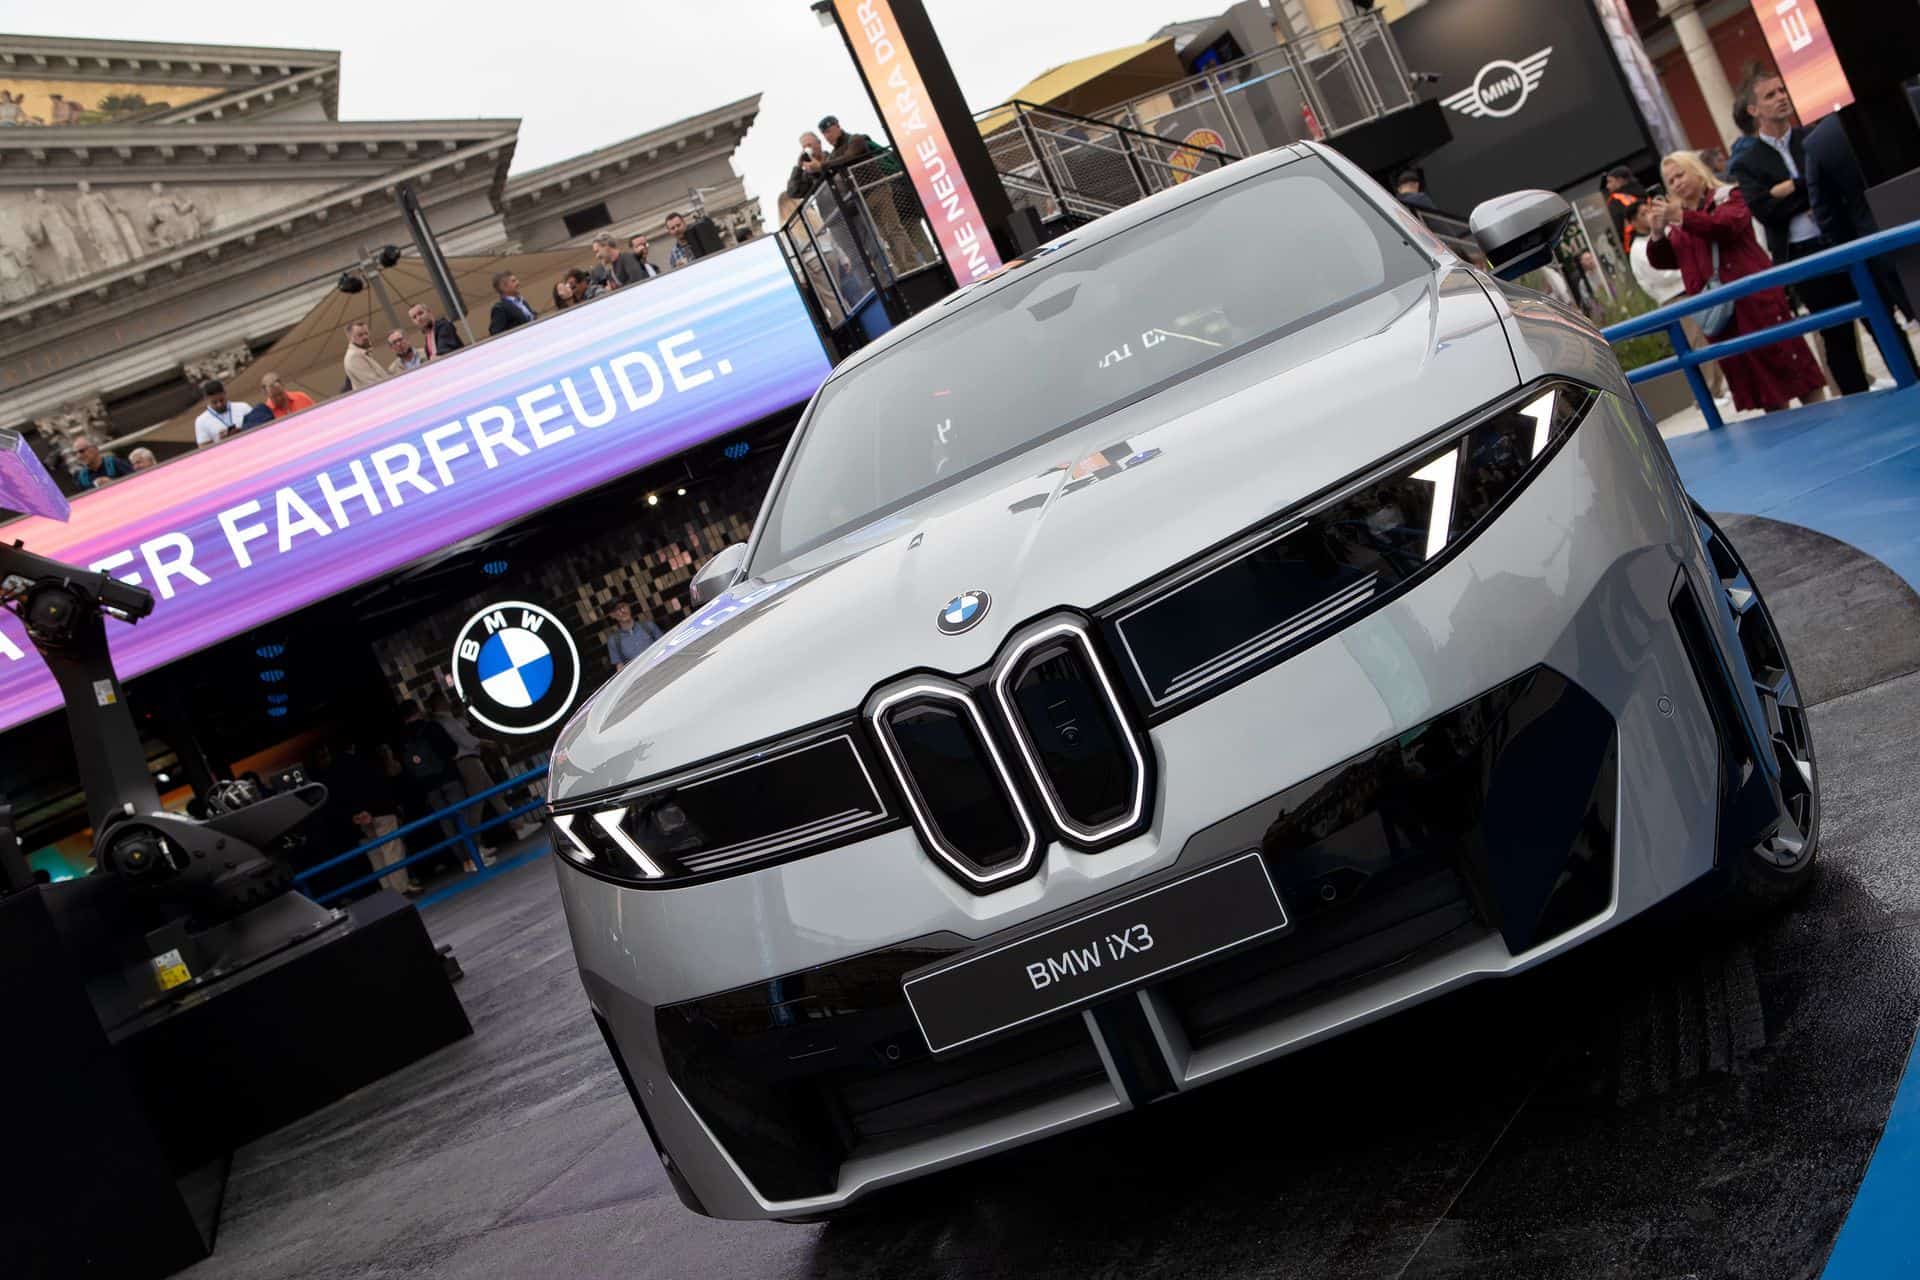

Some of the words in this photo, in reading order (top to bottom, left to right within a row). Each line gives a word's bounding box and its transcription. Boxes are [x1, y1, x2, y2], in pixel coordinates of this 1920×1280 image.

[857, 0, 895, 65] DER
[887, 64, 928, 136] ÄRA
[1480, 73, 1521, 104] MINI
[916, 136, 965, 222] NEUE
[953, 221, 991, 277] INE
[218, 330, 733, 568] FAHRFREUDE.
[460, 610, 545, 662] BMW
[1026, 941, 1101, 990] BMW
[1105, 923, 1154, 960] iX3
